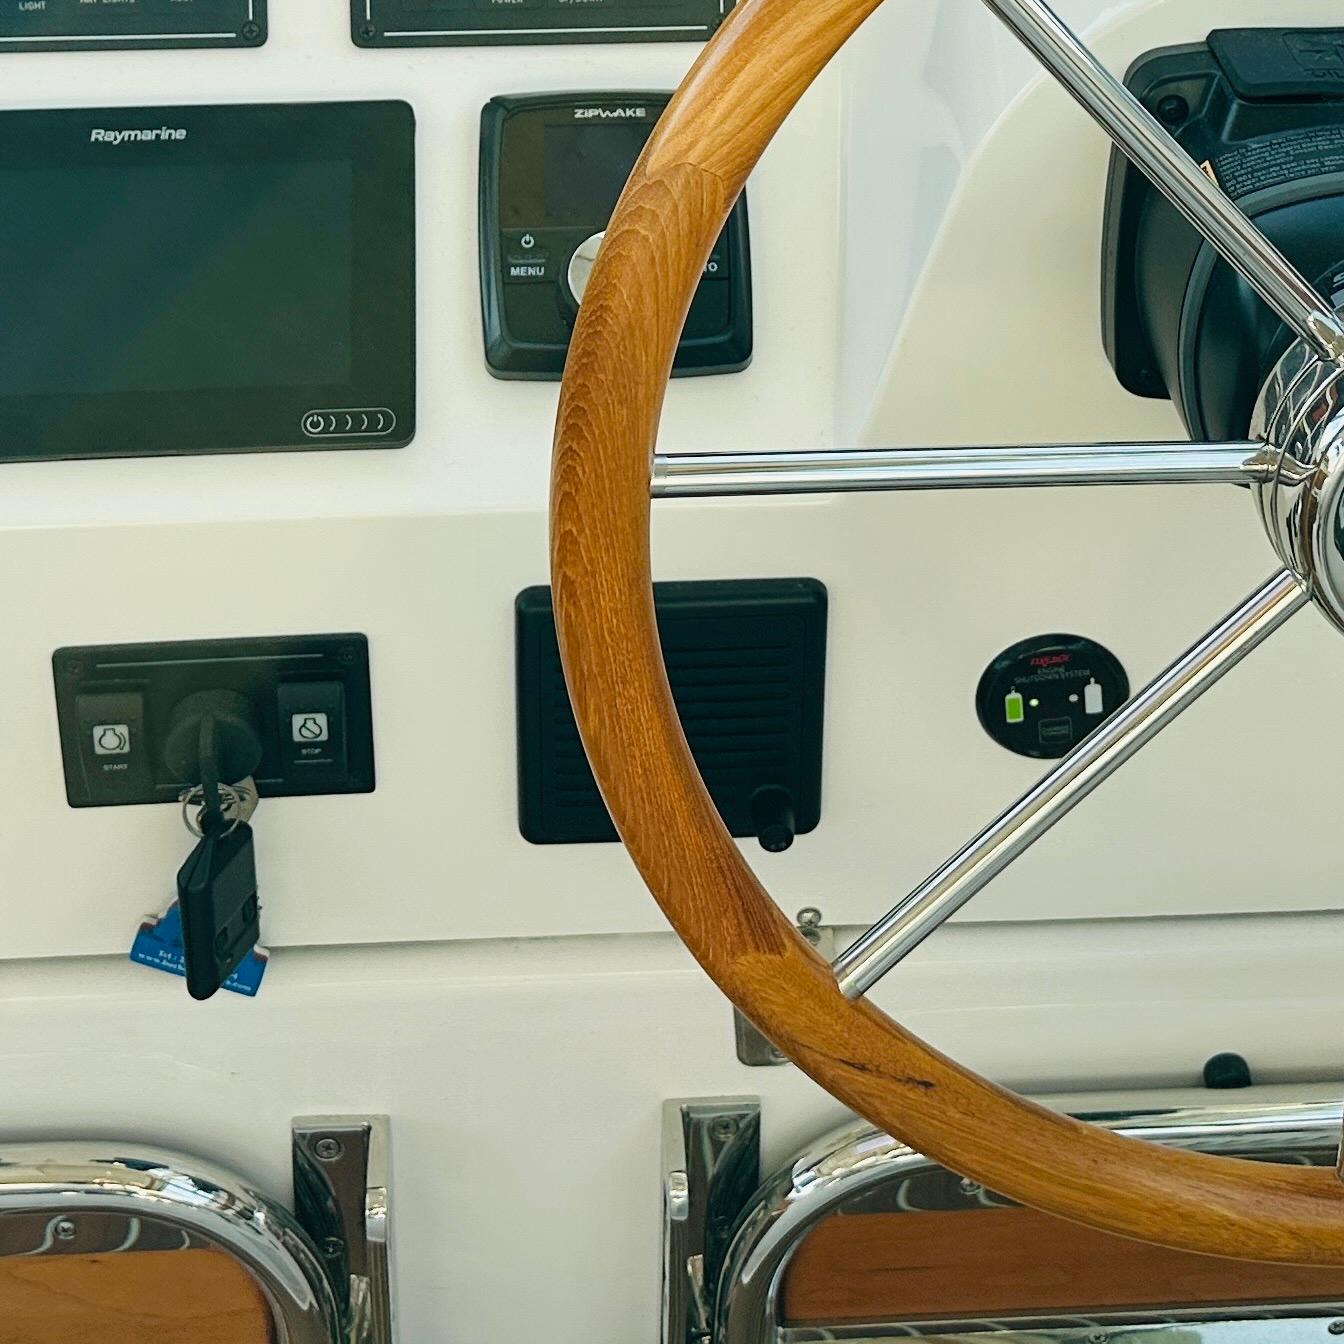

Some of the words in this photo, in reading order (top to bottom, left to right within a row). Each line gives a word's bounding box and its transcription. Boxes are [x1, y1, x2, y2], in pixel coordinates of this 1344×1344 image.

[18, 0, 47, 10] LIGHT
[90, 125, 187, 145] Raymarine
[510, 265, 545, 276] MENU
